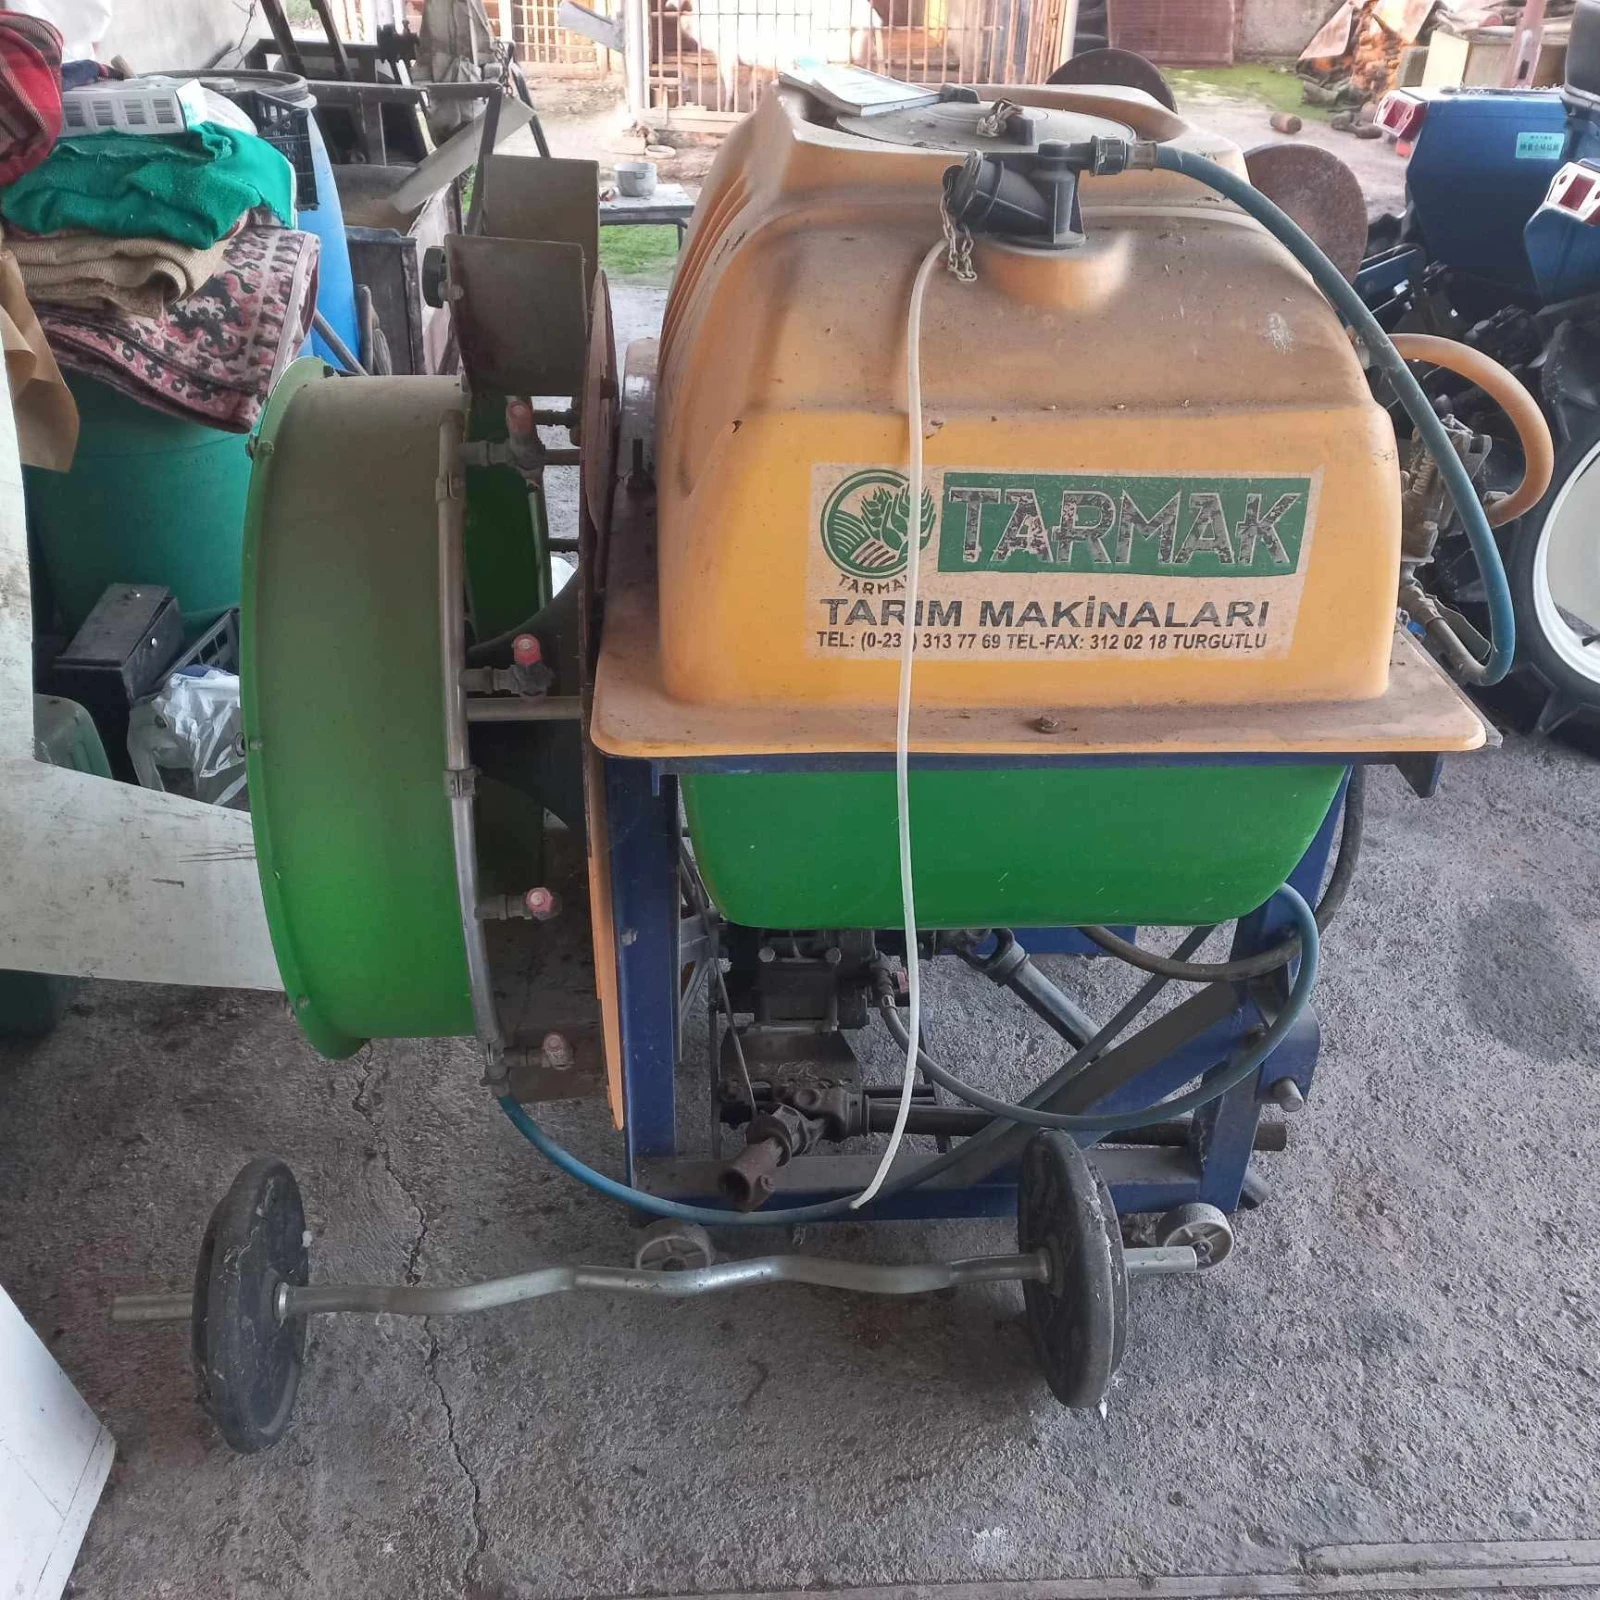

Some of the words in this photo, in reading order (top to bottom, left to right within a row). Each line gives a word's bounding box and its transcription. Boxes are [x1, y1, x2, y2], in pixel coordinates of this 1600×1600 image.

[949, 487, 1301, 565] TARMAK
[820, 598, 963, 627] TARIM
[979, 595, 1270, 628] MAKİNALARI
[816, 631, 855, 648] TEL:
[861, 631, 918, 651] (0-23)
[923, 633, 952, 649] 313
[957, 634, 977, 649] 77
[981, 634, 1001, 650] 69
[1006, 634, 1085, 650] TEL-FAX:
[1089, 634, 1119, 650] 312
[1123, 634, 1143, 650] 02
[1149, 634, 1168, 650] 18
[1172, 633, 1268, 651] TURGUTLU
